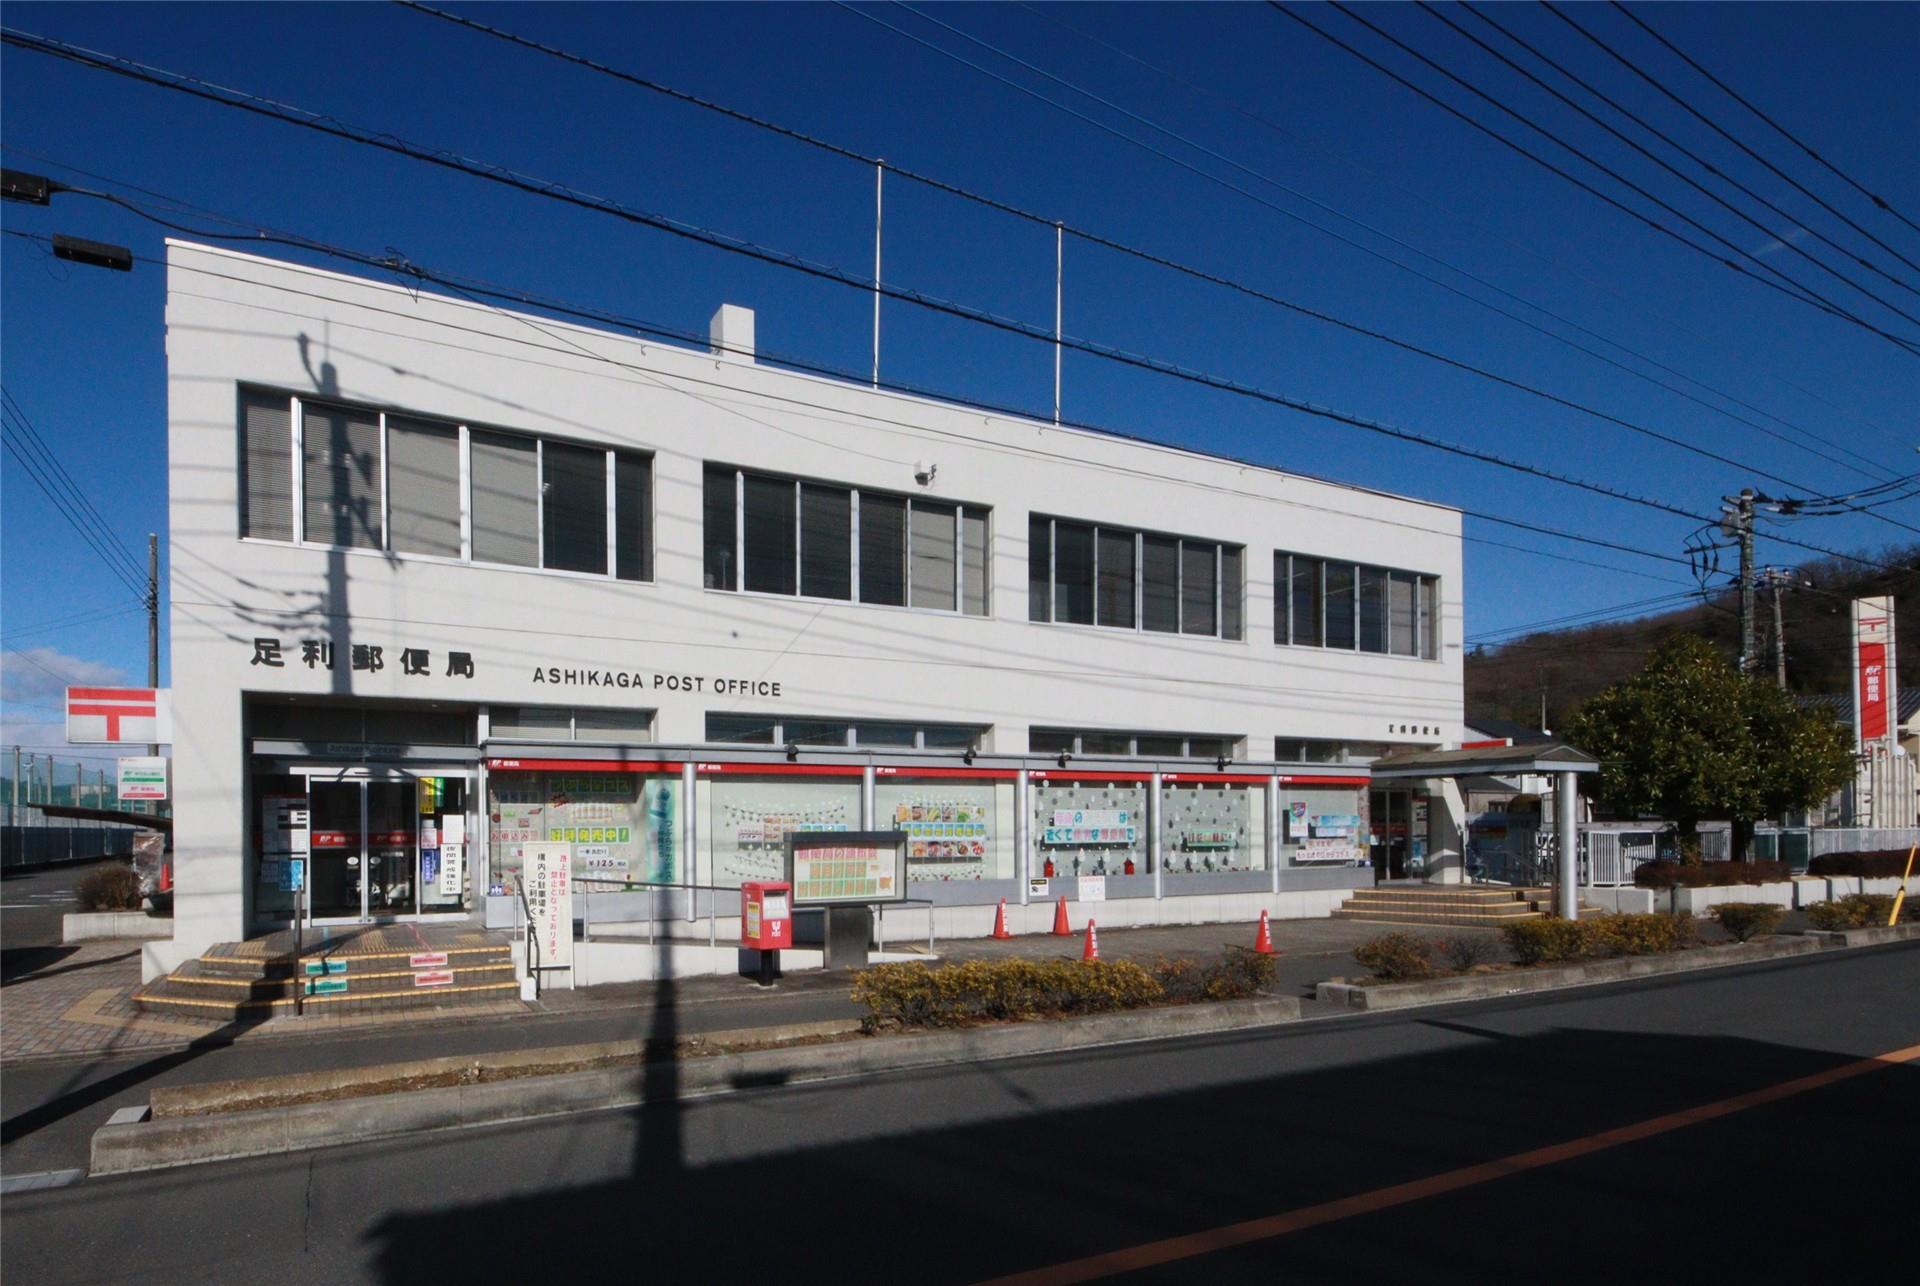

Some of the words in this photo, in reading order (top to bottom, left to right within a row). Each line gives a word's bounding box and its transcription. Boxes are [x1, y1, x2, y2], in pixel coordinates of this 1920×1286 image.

[251, 638, 474, 679] 足利郵便局
[533, 667, 643, 690] ASHIKAGA
[654, 675, 704, 692] POST
[714, 678, 781, 697] OFFICE
